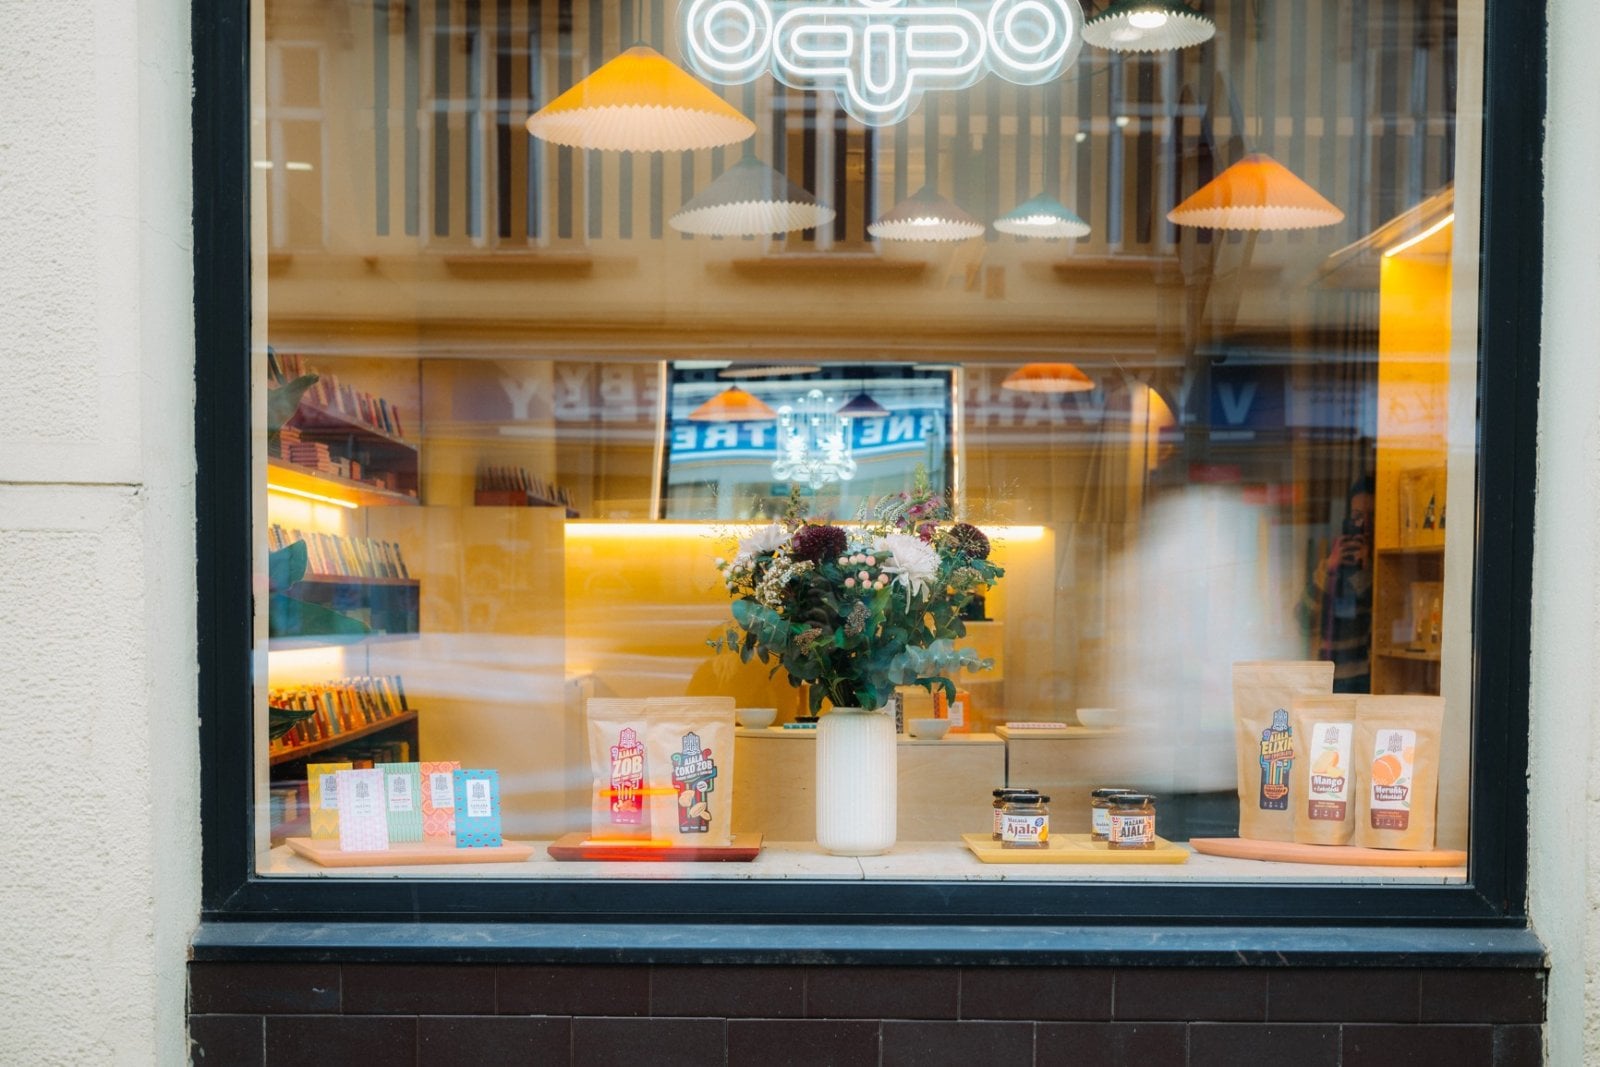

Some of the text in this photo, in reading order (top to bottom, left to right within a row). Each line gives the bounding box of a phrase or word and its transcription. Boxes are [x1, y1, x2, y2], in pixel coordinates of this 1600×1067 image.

[612, 755, 642, 778] ZOB
[696, 760, 712, 773] ZOB
[1313, 776, 1343, 786] Mango
[1007, 823, 1038, 838] Ajala
[1119, 825, 1147, 838] AJALA
